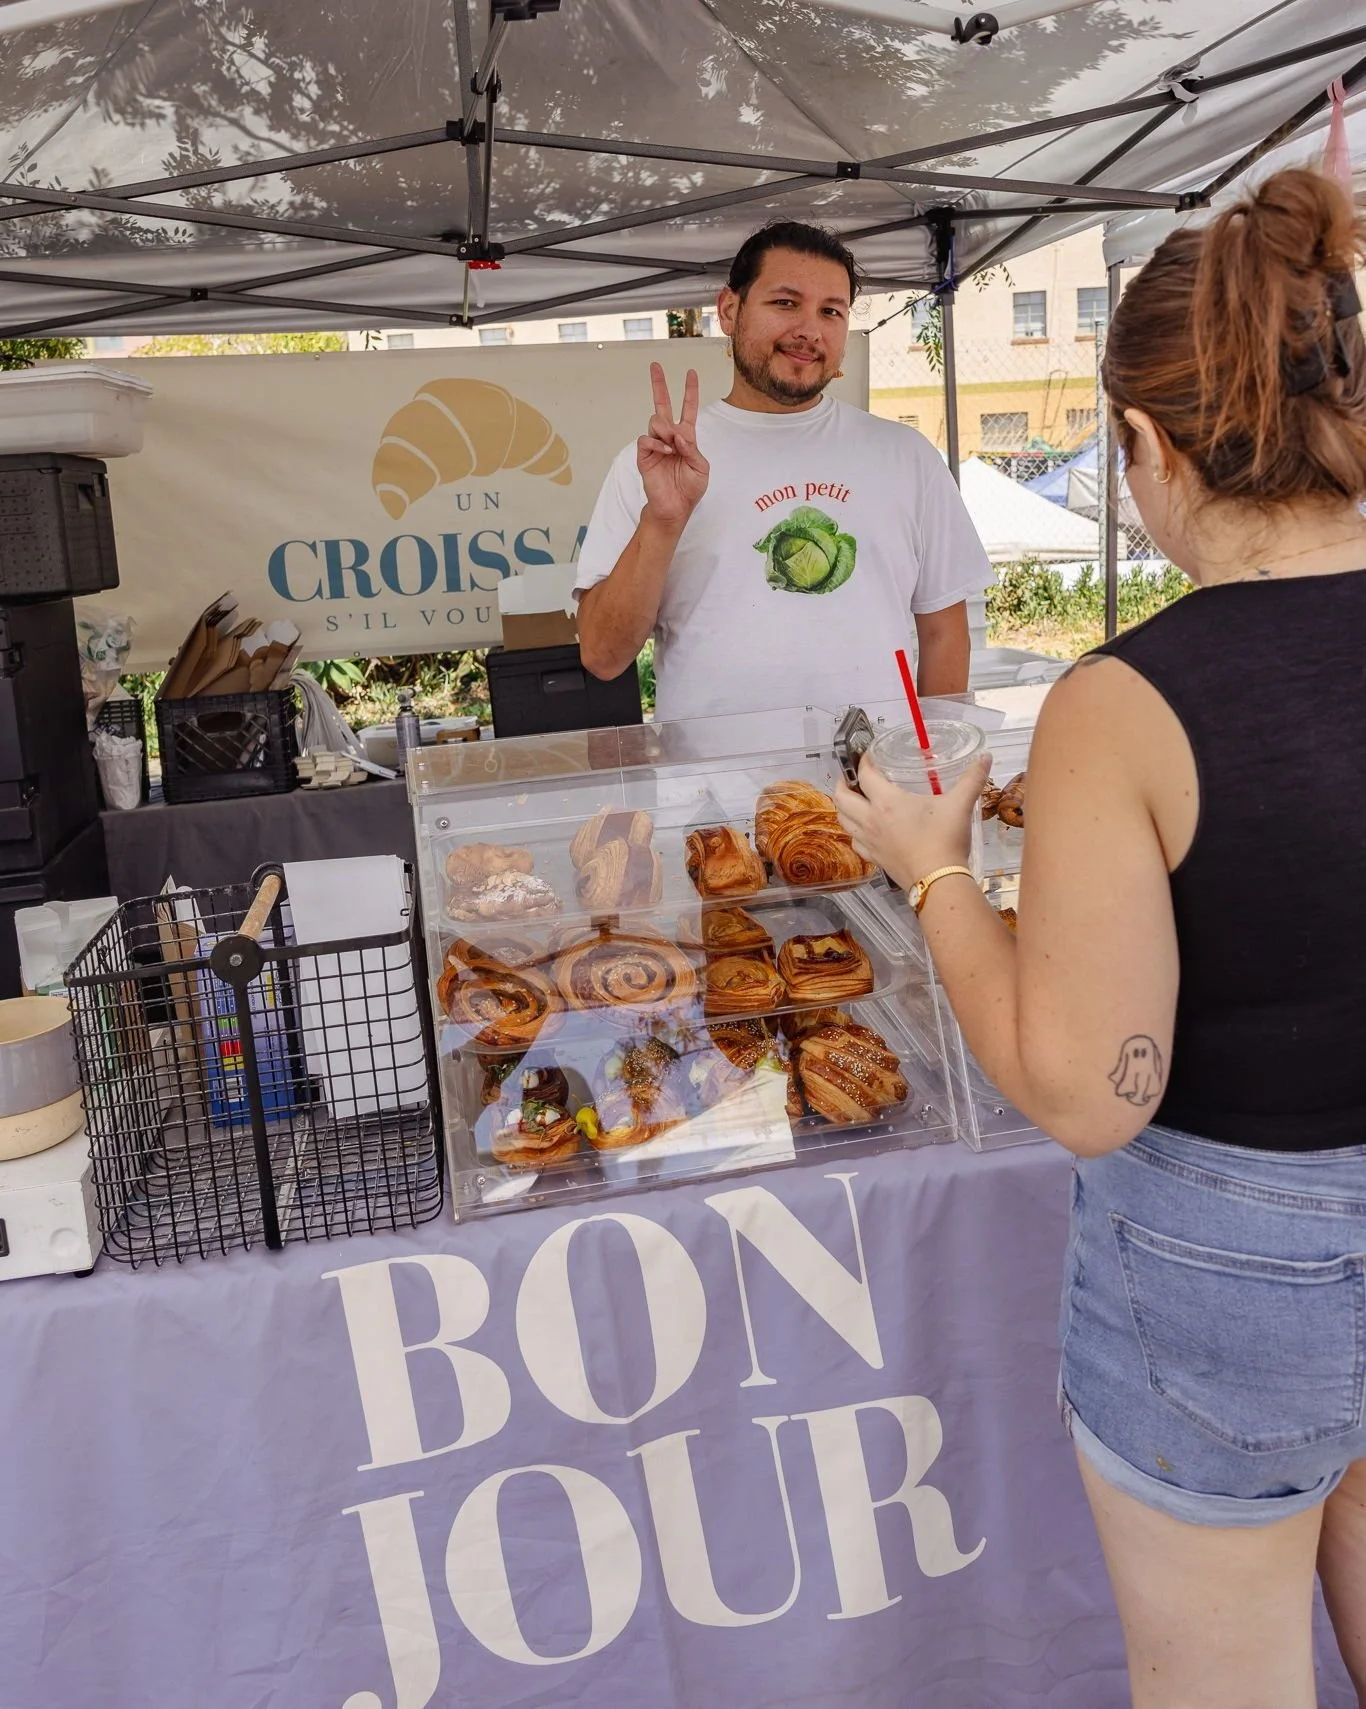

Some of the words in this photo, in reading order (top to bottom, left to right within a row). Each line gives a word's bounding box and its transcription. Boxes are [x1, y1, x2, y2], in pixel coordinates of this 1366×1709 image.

[456, 491, 501, 511] UN
[754, 484, 797, 512] mon
[804, 481, 850, 503] petit
[326, 612, 397, 632] S'IL
[320, 1171, 885, 1472] BON
[340, 1395, 987, 1709] JOUR
